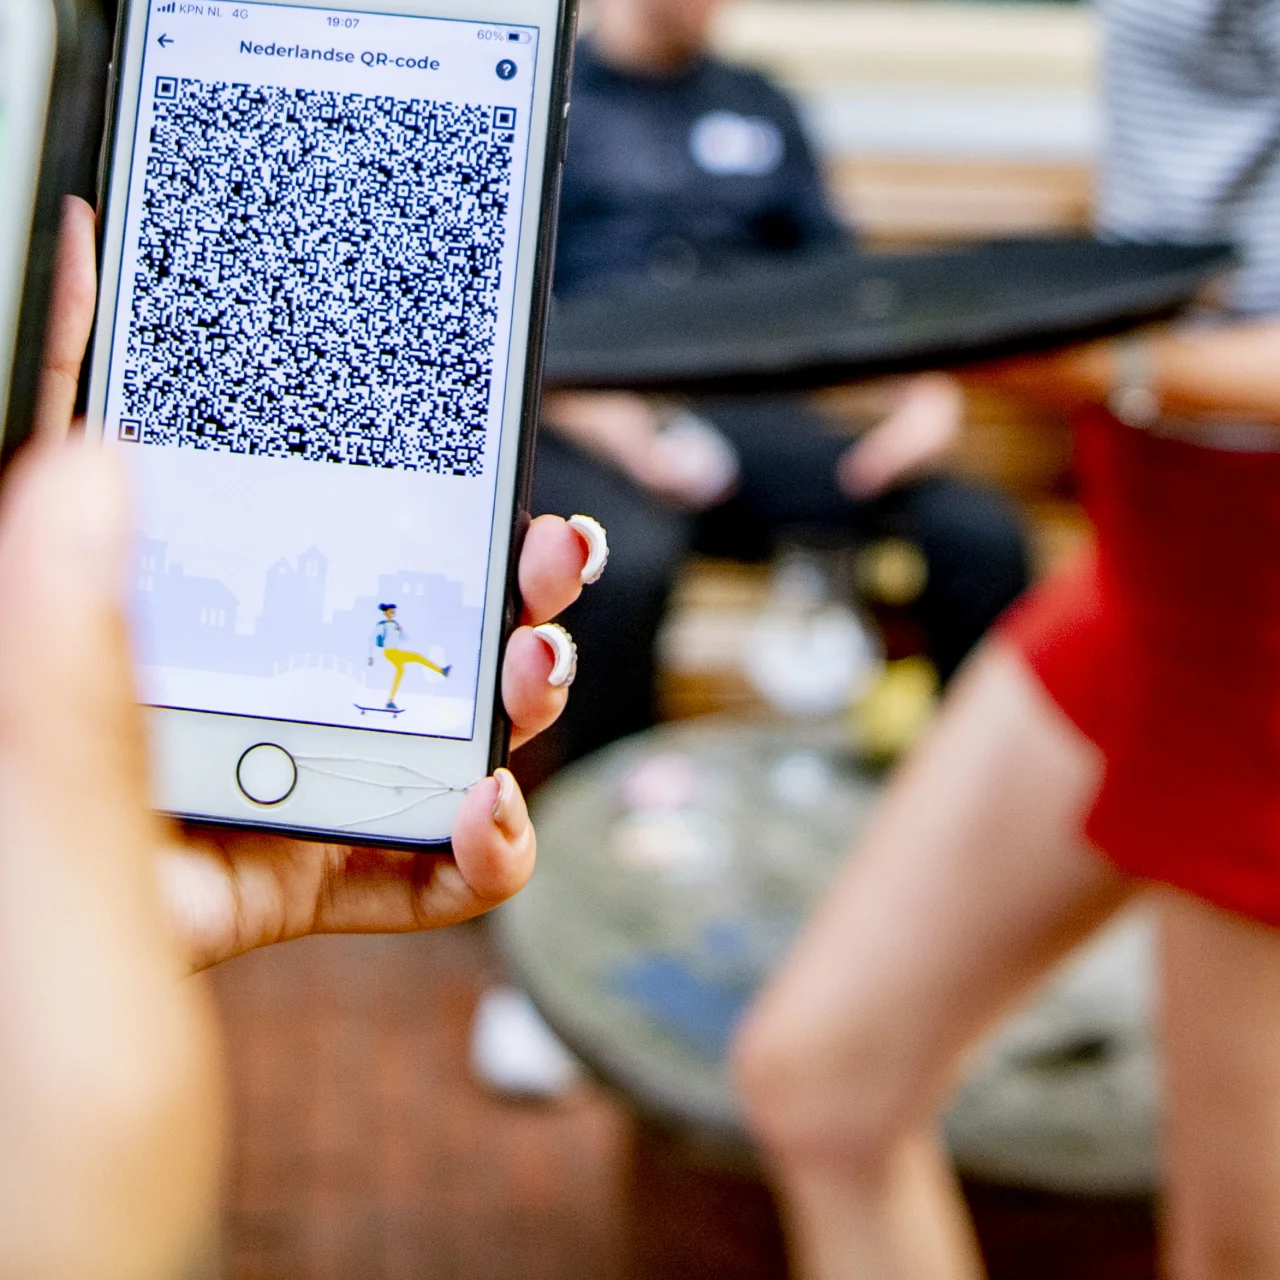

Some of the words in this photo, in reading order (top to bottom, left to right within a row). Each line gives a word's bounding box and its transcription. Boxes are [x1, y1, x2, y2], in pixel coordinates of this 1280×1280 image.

[179, 4, 204, 16] KPN
[207, 5, 222, 18] NL
[232, 8, 249, 20] 4G
[326, 16, 360, 29] 19:07
[476, 29, 504, 42] 60%
[239, 40, 356, 64] Nederlandse
[360, 50, 441, 71] QR-code
